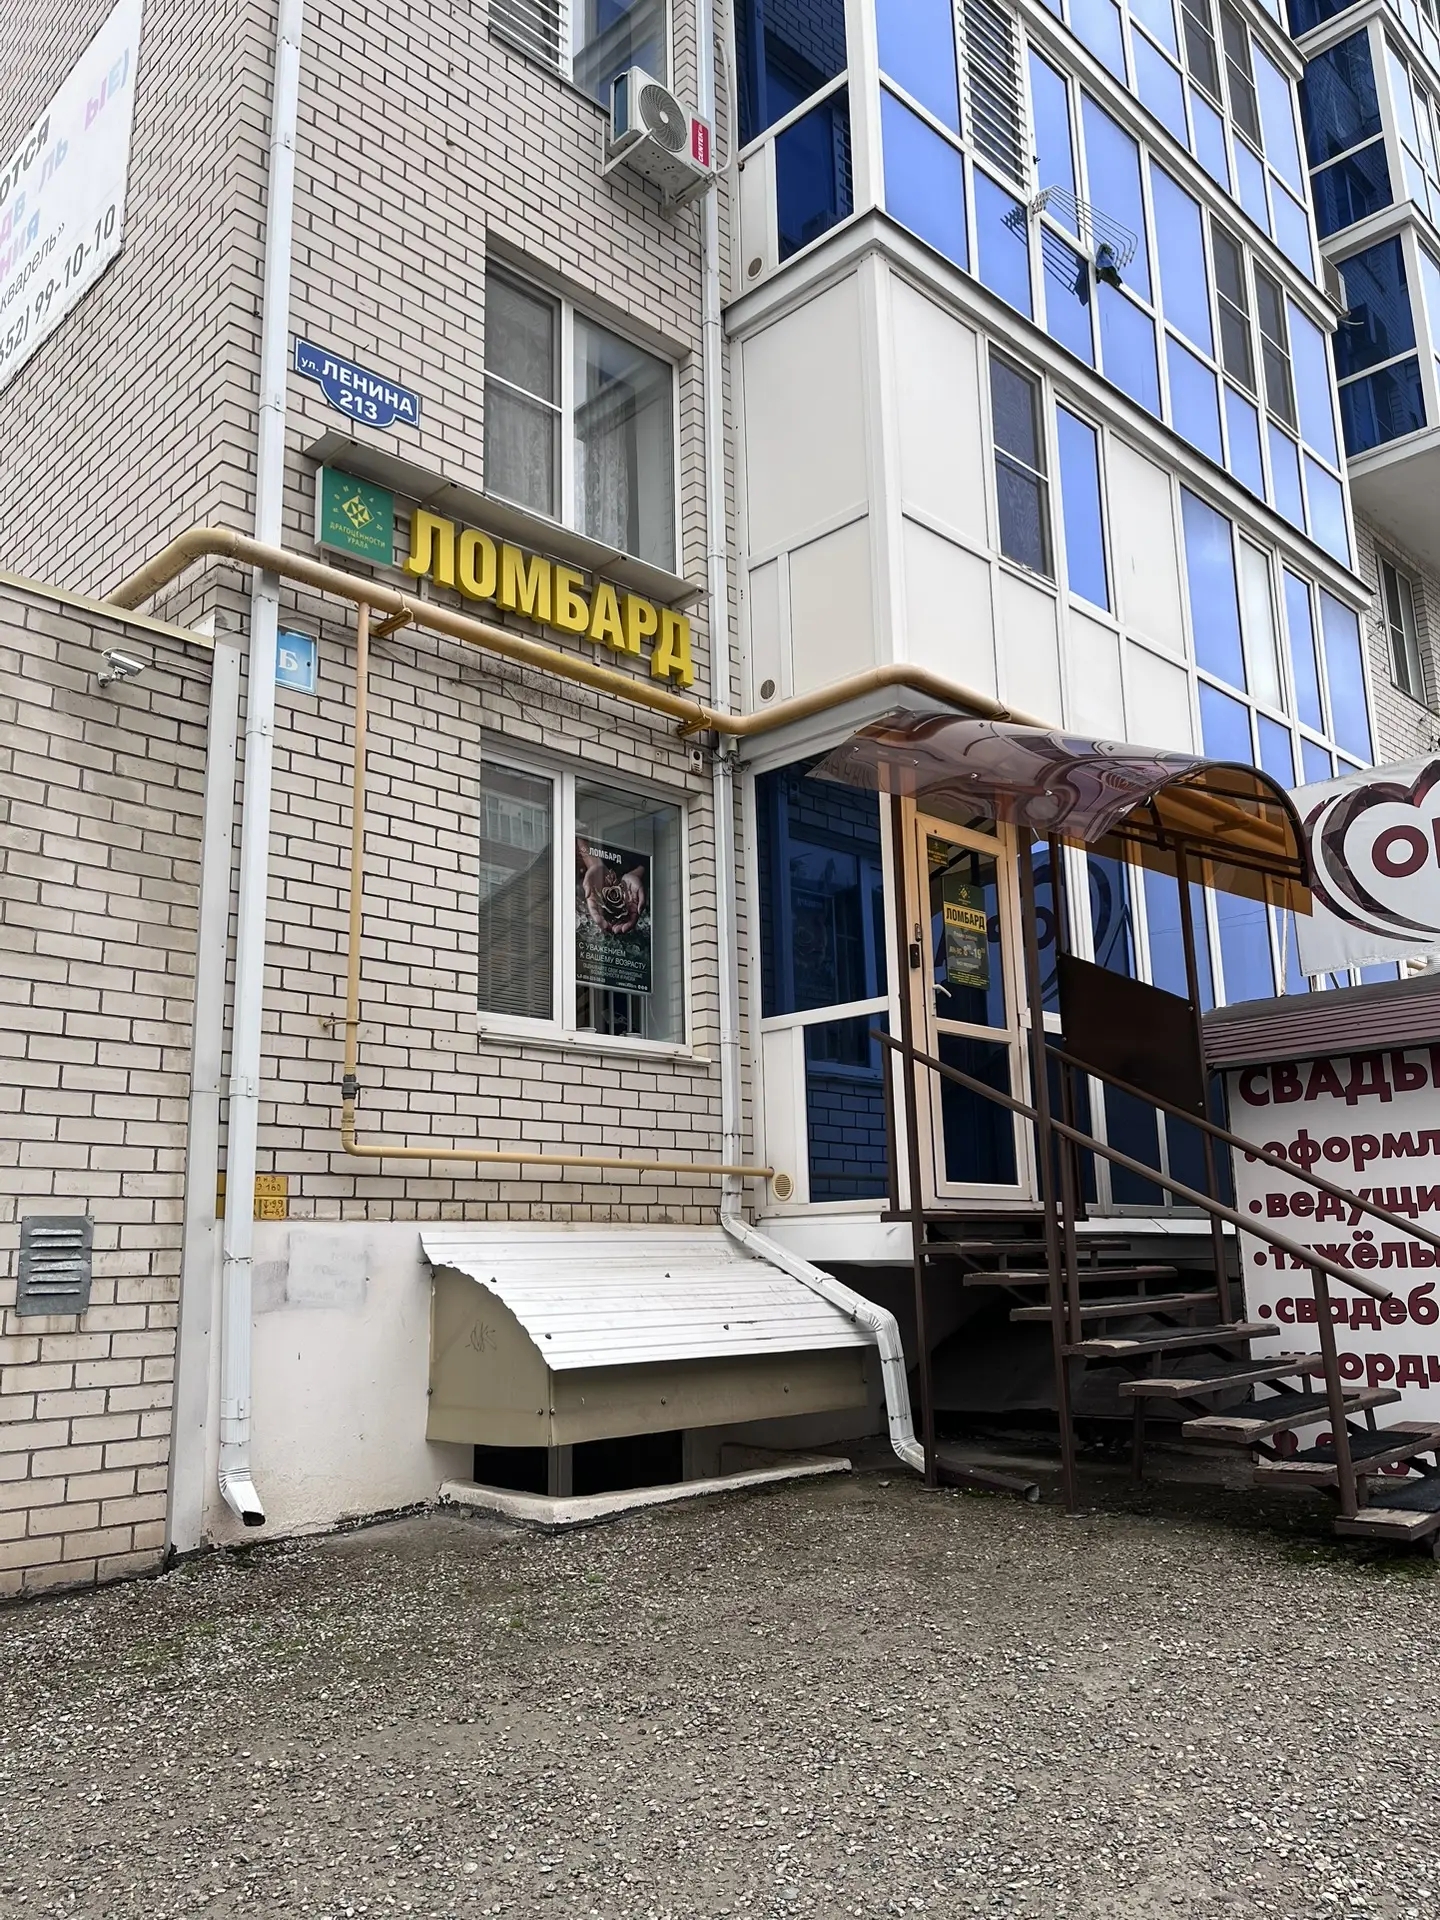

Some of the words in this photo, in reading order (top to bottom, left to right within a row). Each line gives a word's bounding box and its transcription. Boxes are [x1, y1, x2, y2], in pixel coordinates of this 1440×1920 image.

[35, 204, 116, 325] 99-10-10
[301, 357, 319, 372] ул.
[322, 360, 413, 416] ЛЕНИНА
[340, 389, 377, 420] 213
[329, 521, 386, 549] ДРАГОЦЕННОСТИ
[347, 536, 369, 550] УРАЛА
[403, 508, 693, 687] ЛОМБАРД
[279, 648, 298, 671] Б
[589, 847, 622, 865] ЛОМБАРД
[1372, 817, 1440, 878] О
[946, 907, 986, 931] ЛОМБАРД
[578, 941, 585, 949] С
[585, 943, 626, 957] УВАЖЕНИЕМ
[580, 951, 585, 959] К
[586, 953, 614, 964] ВАШЕМУ
[615, 957, 647, 970] ВОЗРАСТУ
[1239, 1050, 1440, 1106] СВАДЬ
